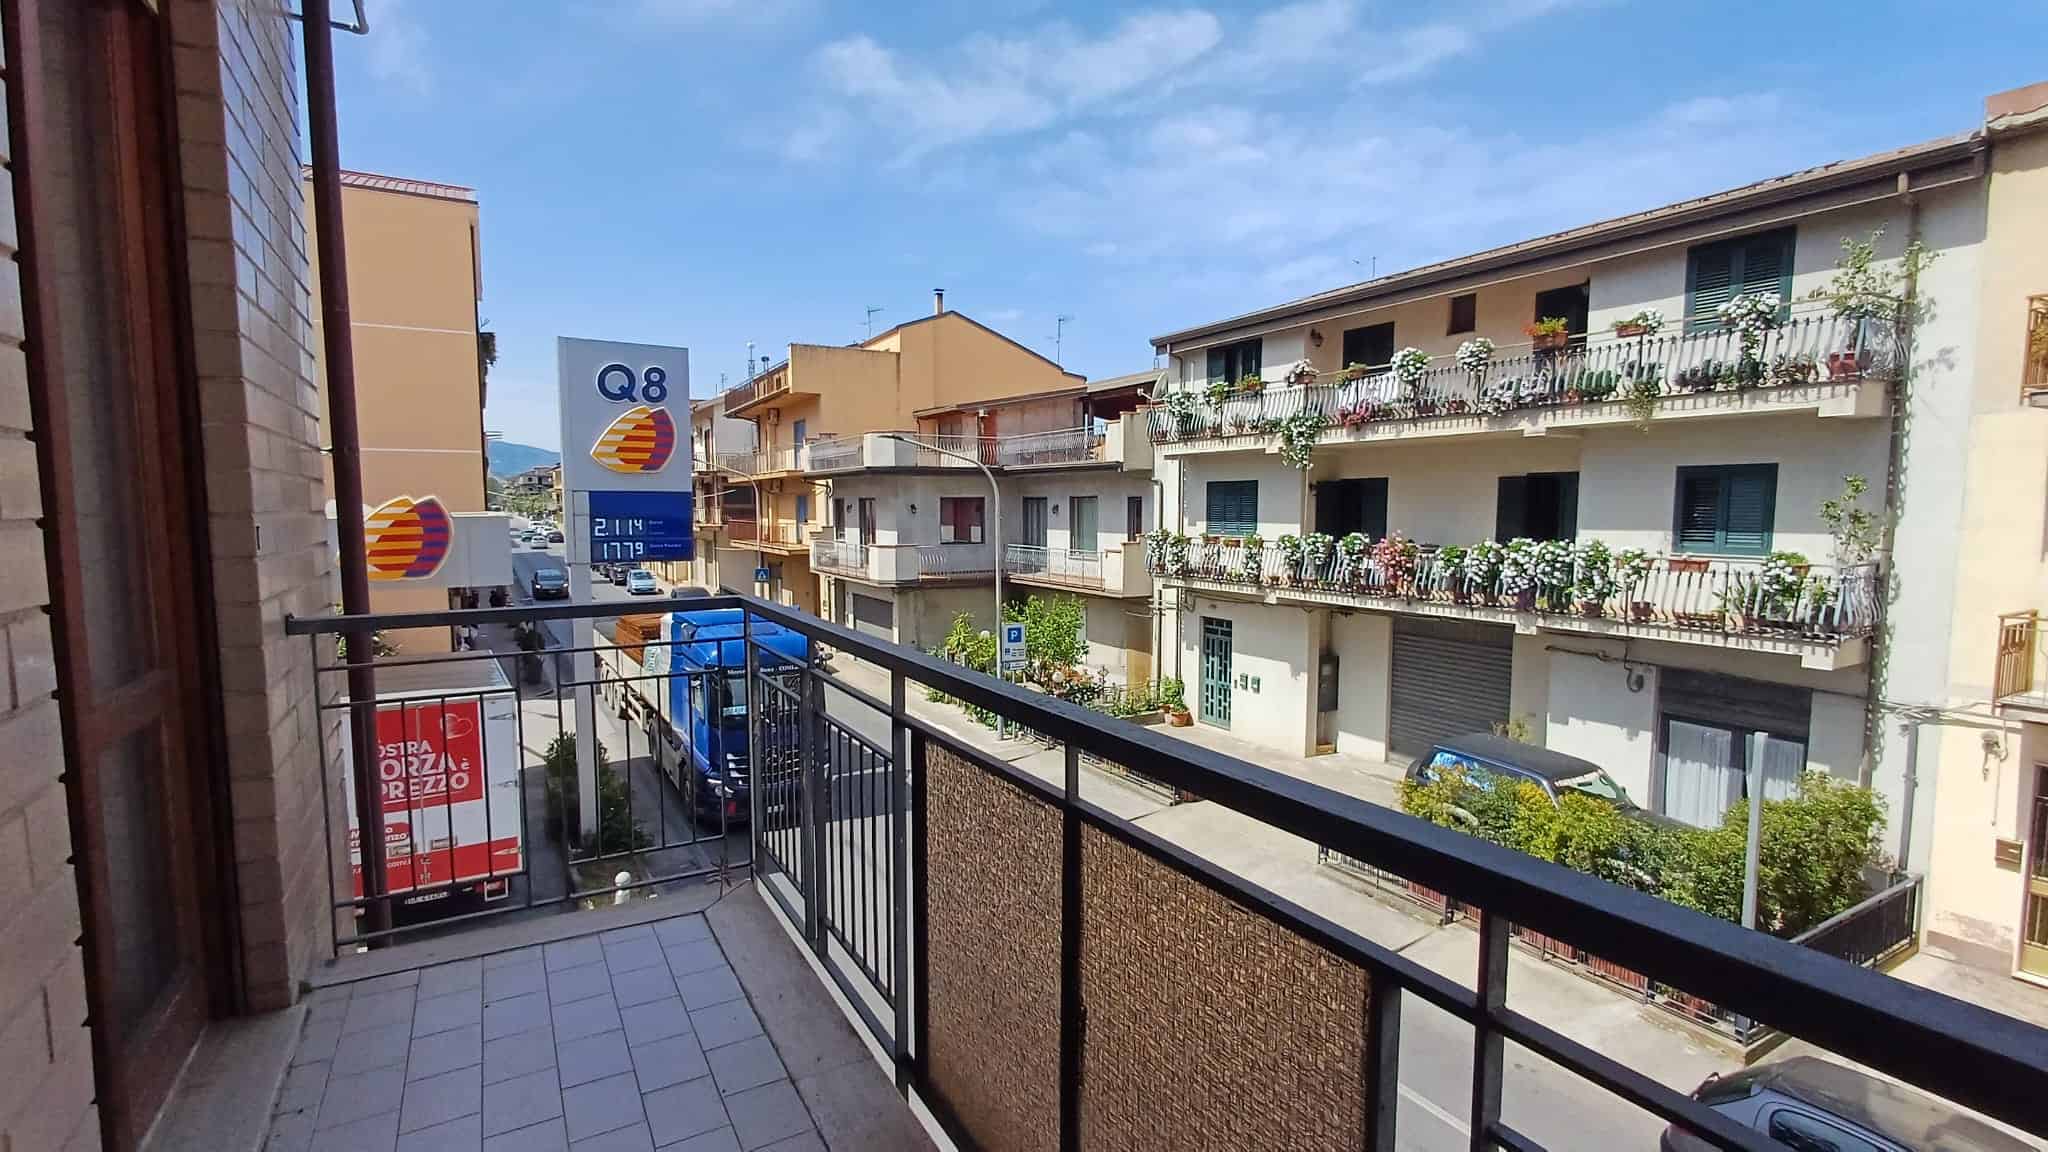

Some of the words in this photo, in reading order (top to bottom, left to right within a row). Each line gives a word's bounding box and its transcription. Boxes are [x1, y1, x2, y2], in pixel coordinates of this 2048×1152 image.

[597, 363, 668, 403] Q8
[1010, 630, 1018, 640] P
[378, 740, 433, 758] OSTRA
[380, 752, 457, 780] ORZA
